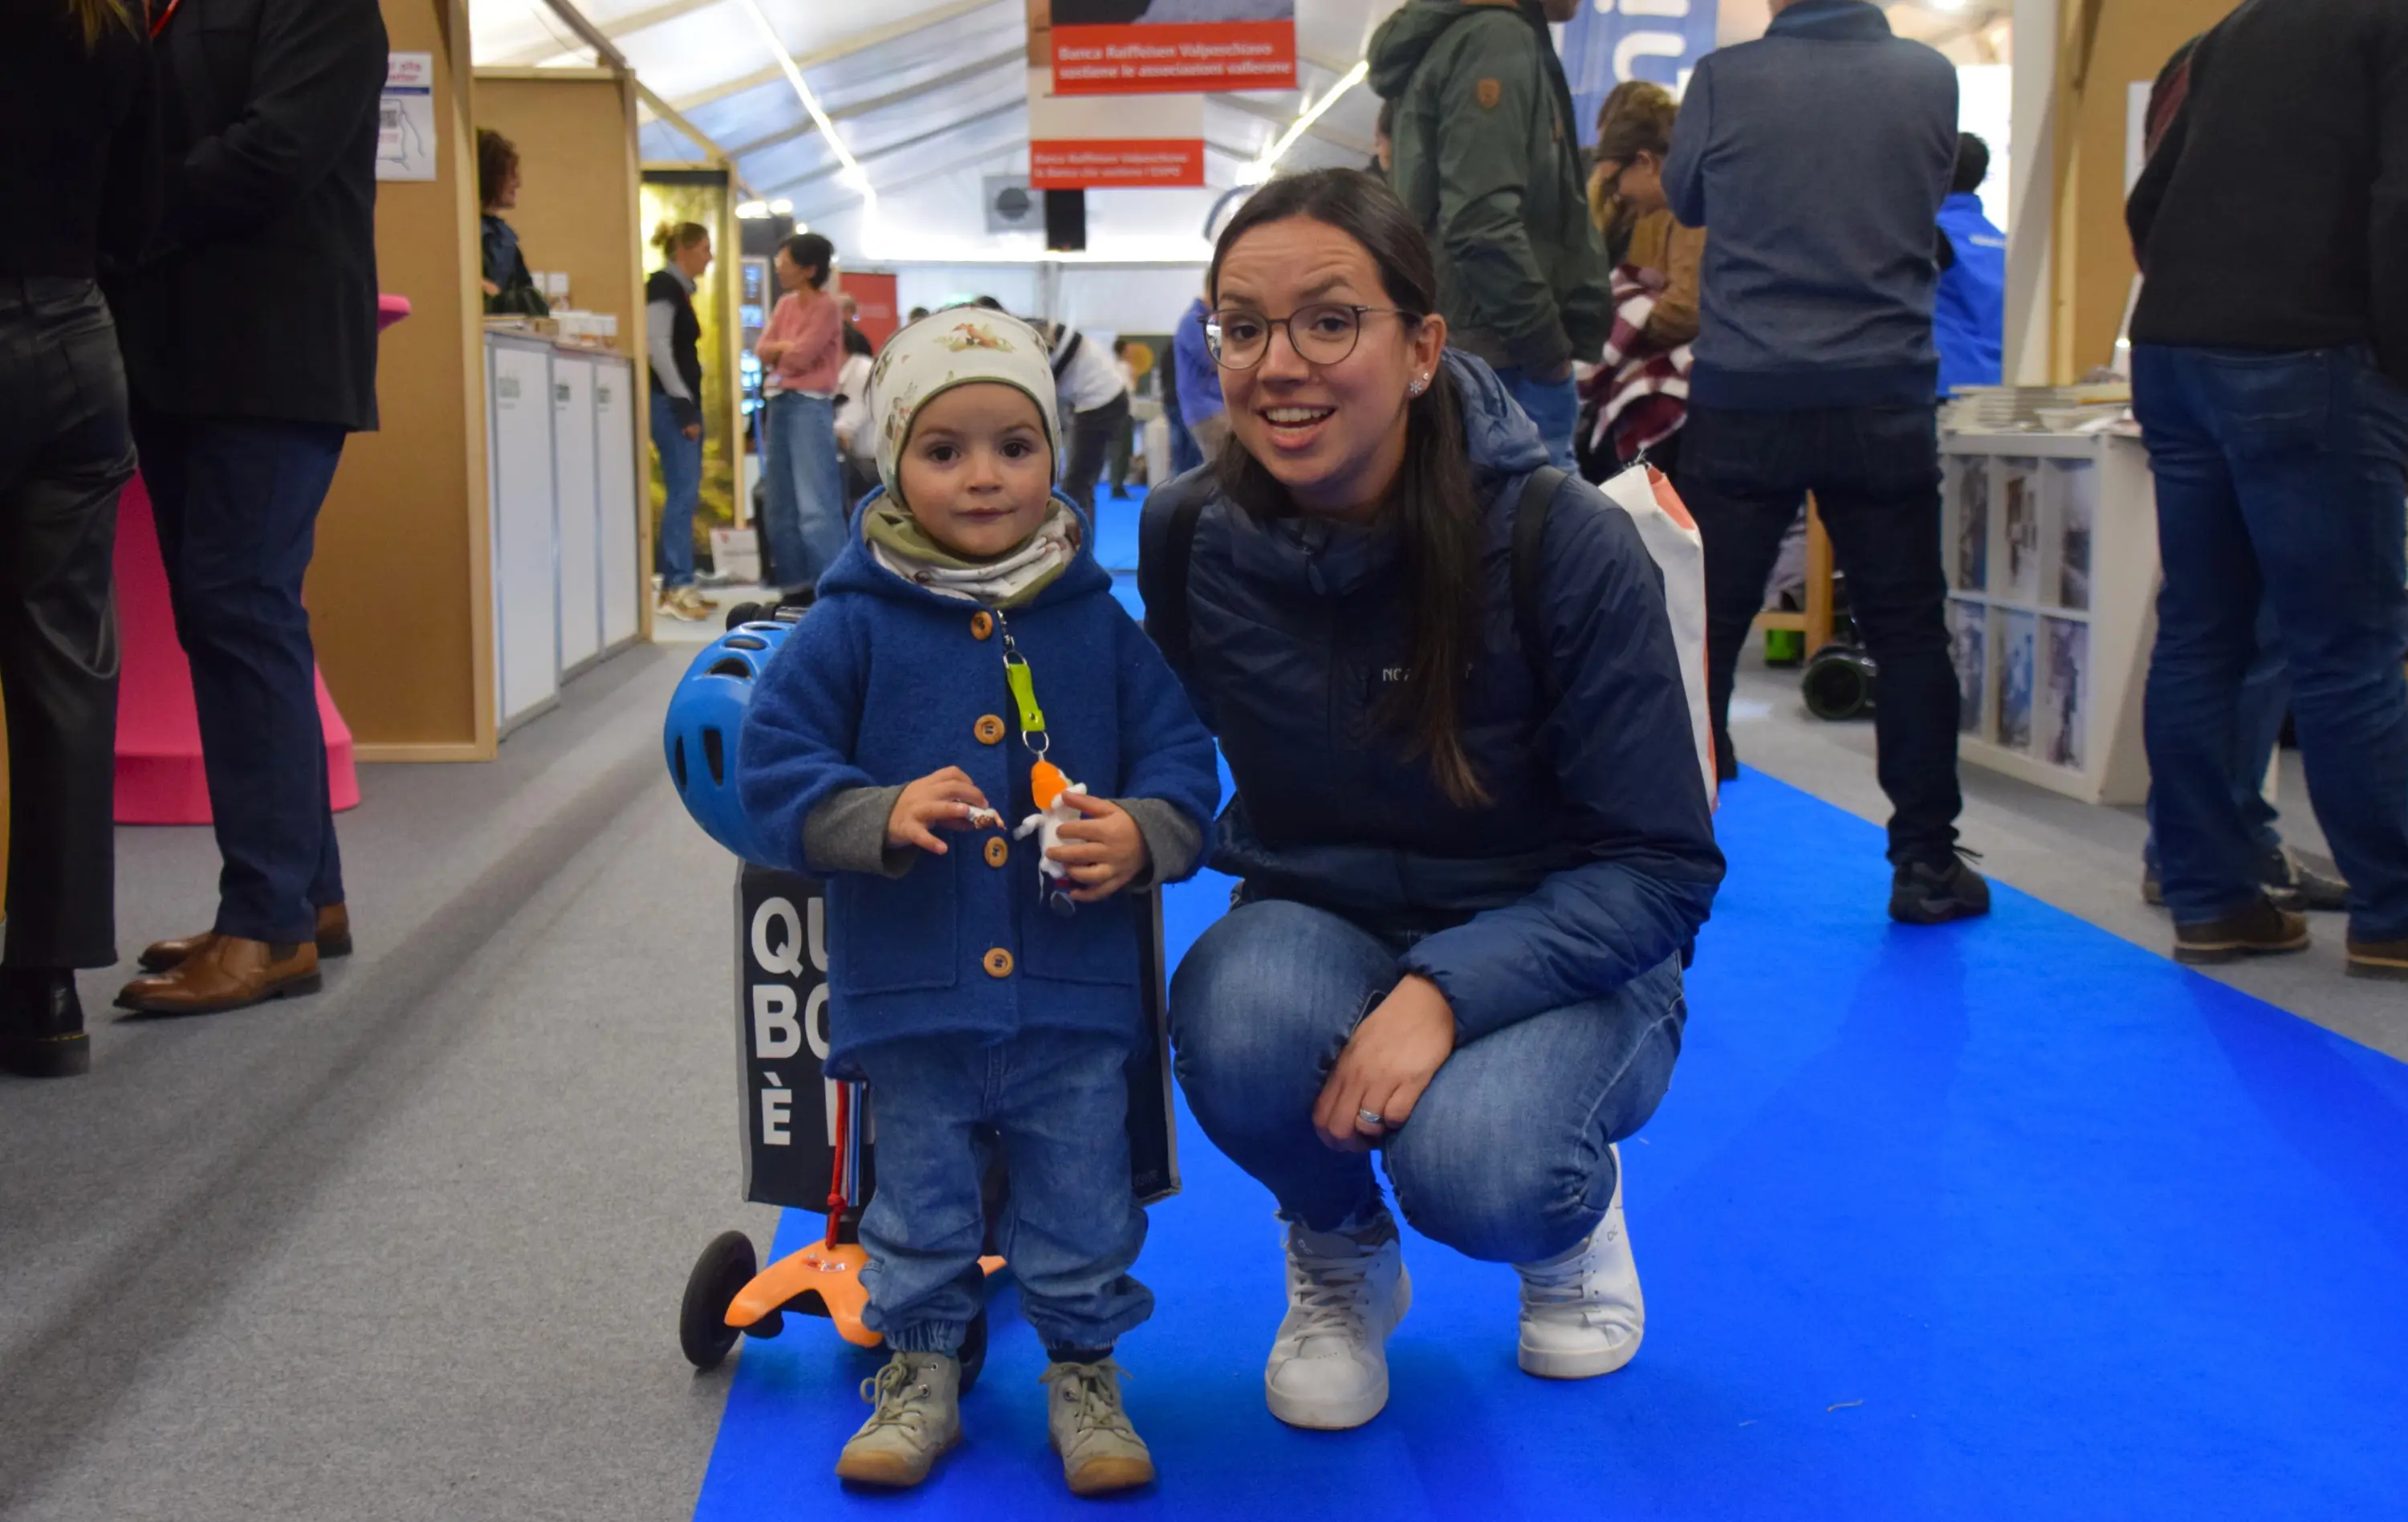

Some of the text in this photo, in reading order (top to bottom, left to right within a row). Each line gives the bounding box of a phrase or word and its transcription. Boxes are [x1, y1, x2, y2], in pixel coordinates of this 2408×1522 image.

[1058, 41, 1274, 60] Banca Raiffeisen Valposchiavo
[1059, 64, 1117, 79] sostiene
[1121, 63, 1134, 78] le
[1035, 152, 1065, 165] Banca
[762, 1072, 792, 1146] È
